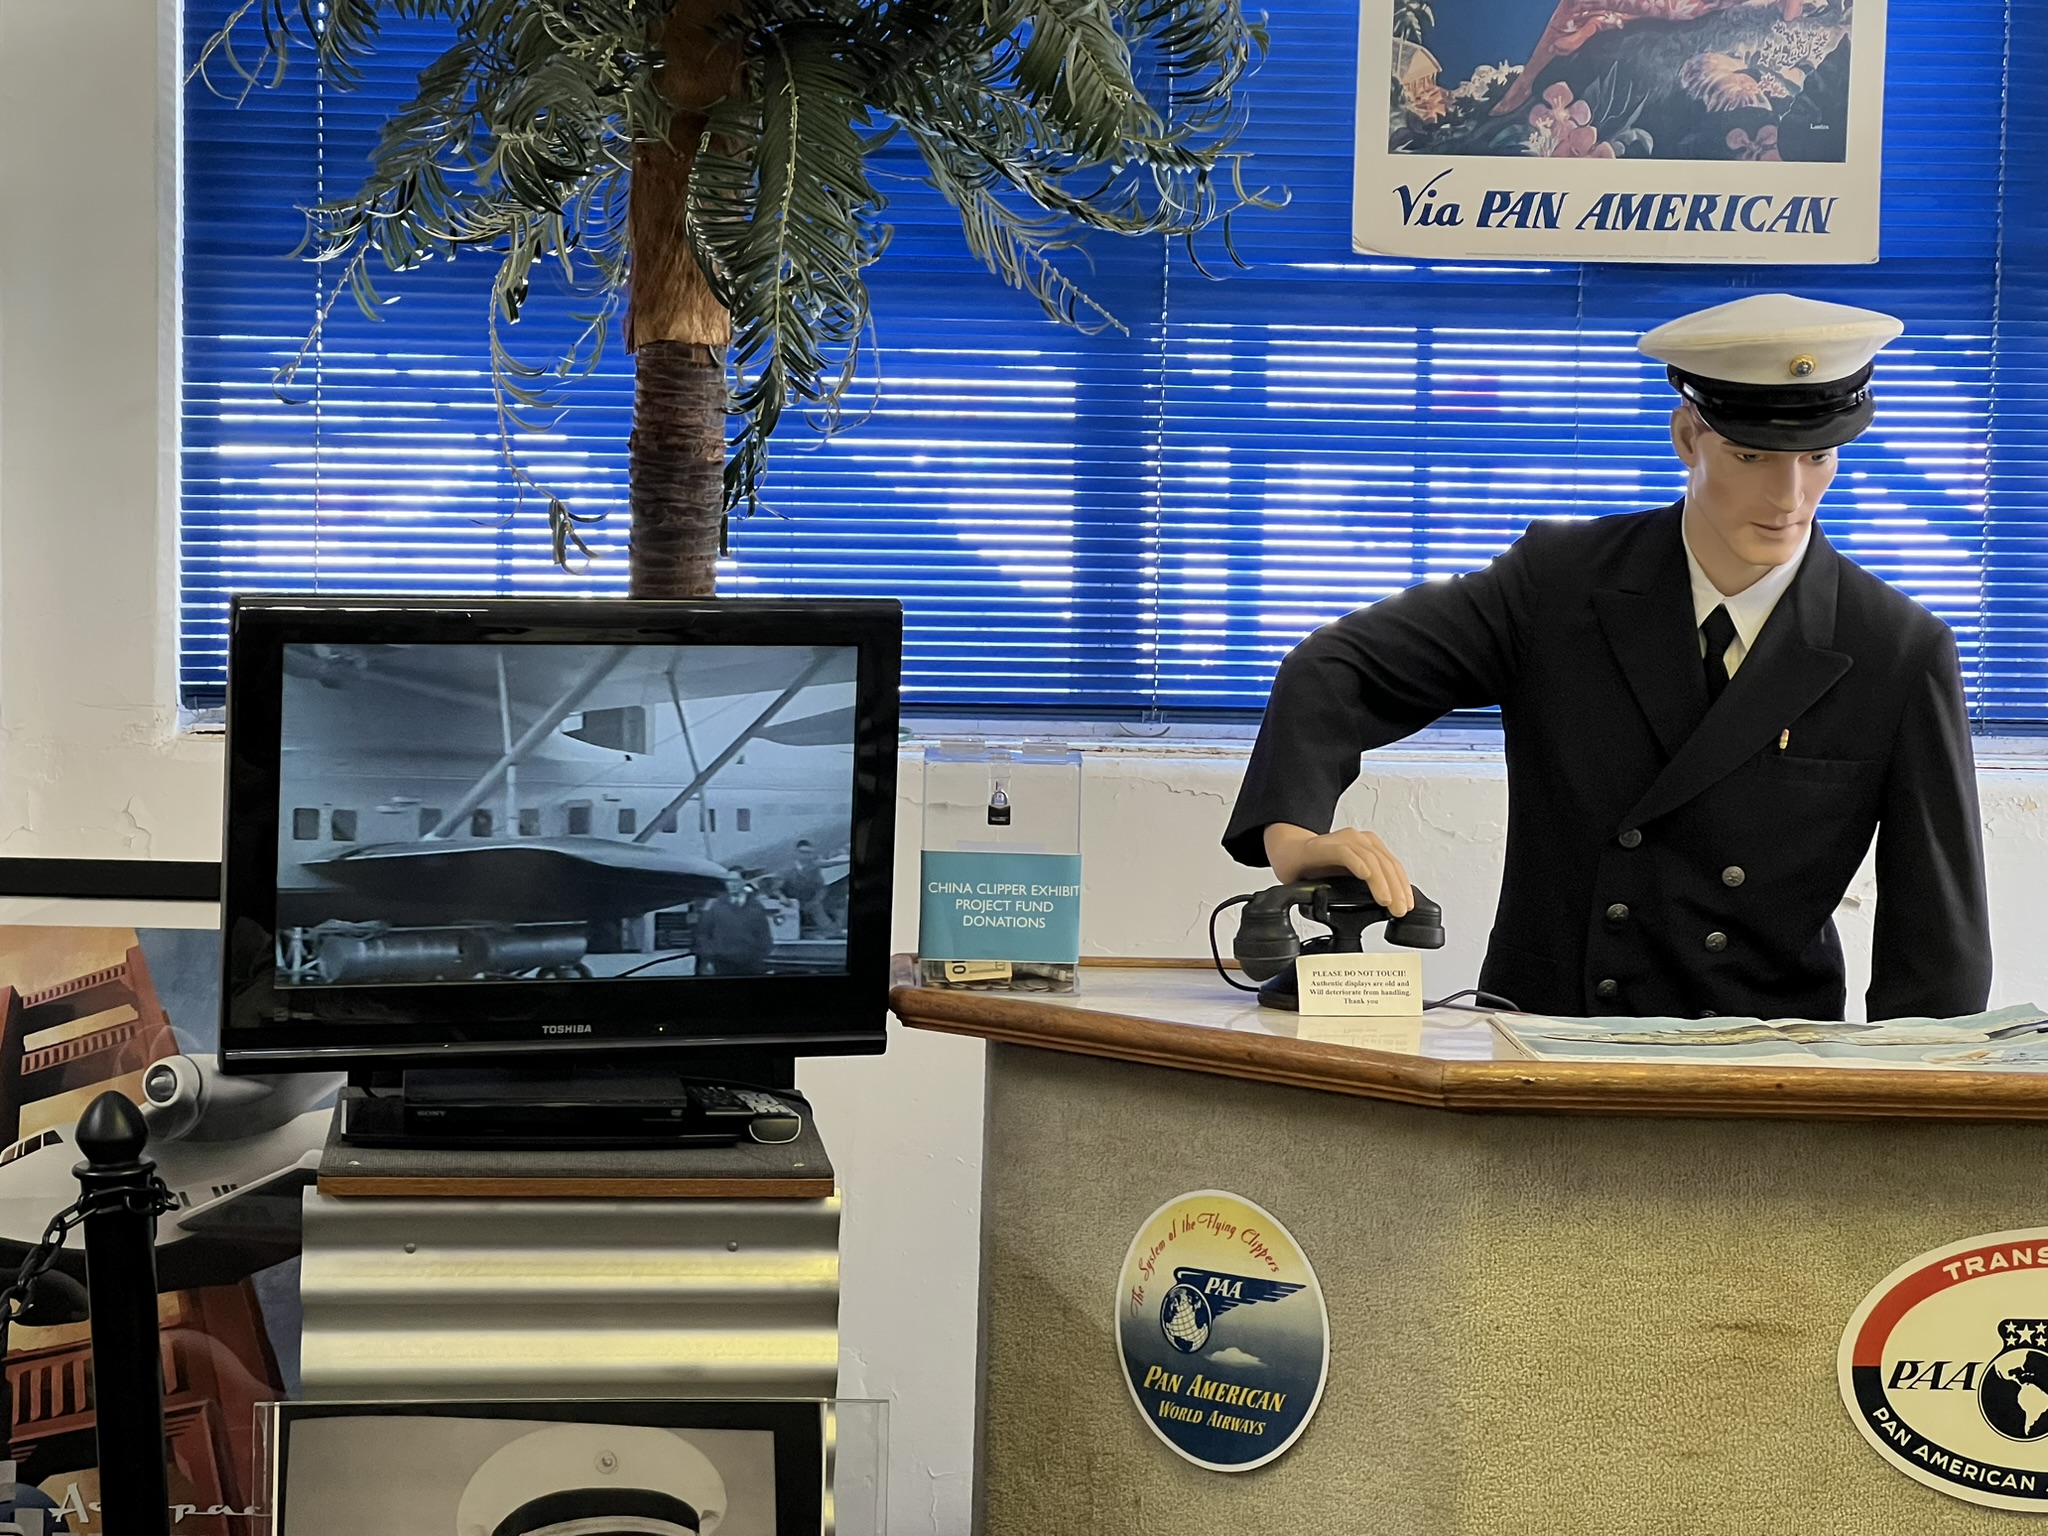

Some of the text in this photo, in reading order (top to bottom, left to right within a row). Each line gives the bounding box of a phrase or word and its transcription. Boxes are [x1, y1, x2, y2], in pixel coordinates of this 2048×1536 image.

[1393, 168, 1839, 234] Via PAN AMERICAN
[928, 882, 1080, 897] CHINA CLIPPER EXHIBIT
[955, 899, 1054, 913] PROJECT FUND
[963, 916, 1046, 929] DONATIONS
[1344, 980, 1371, 988] displays
[1325, 988, 1361, 996] deteriorate
[1362, 988, 1379, 996] from
[542, 1025, 592, 1034] TOSHIBA
[1130, 1212, 1280, 1319] The System of the Flying Clippers
[1204, 1276, 1244, 1299] PAA
[1886, 1360, 1985, 1391] PAA
[1872, 1406, 2036, 1491] PAN AMERICAN
